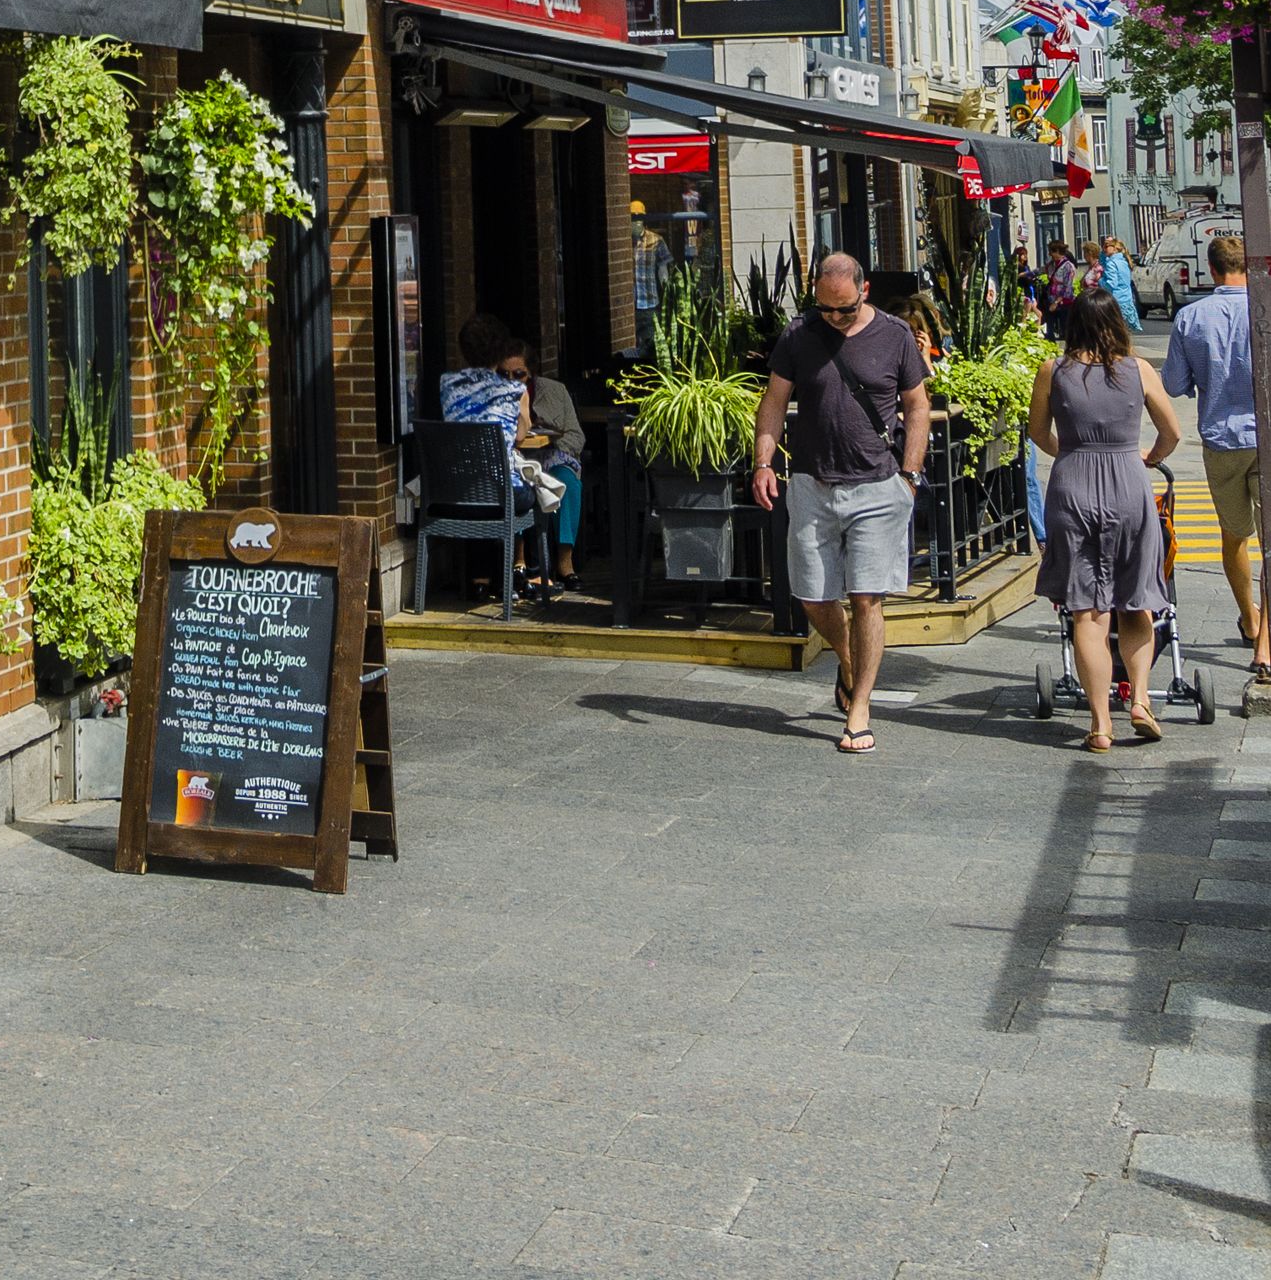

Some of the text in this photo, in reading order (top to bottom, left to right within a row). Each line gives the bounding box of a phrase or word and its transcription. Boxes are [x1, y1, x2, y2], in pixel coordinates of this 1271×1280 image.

[189, 566, 320, 596] TOURNEBROCHE
[196, 592, 291, 618] C'EST QUOI?
[175, 608, 245, 625] Le POULET bio de
[259, 617, 310, 638] Charlevoix
[173, 638, 235, 654] La PINTADE de
[242, 648, 261, 669] Cap
[174, 674, 201, 686] BREAD
[202, 678, 220, 689] made
[185, 664, 204, 676] PAIN
[206, 665, 224, 677] fait
[237, 668, 261, 682] farine
[266, 673, 279, 683] bio
[215, 703, 231, 713] sur
[234, 703, 256, 716] place
[183, 731, 246, 748] MICROBRASSERIE
[248, 726, 258, 737] de
[260, 727, 269, 739] la
[217, 748, 244, 760] BEER
[244, 776, 302, 793] AUTHENTIQUE
[235, 788, 257, 797] DEPUIS
[258, 788, 287, 801] 1988
[255, 801, 288, 811] AUTHENTIC
